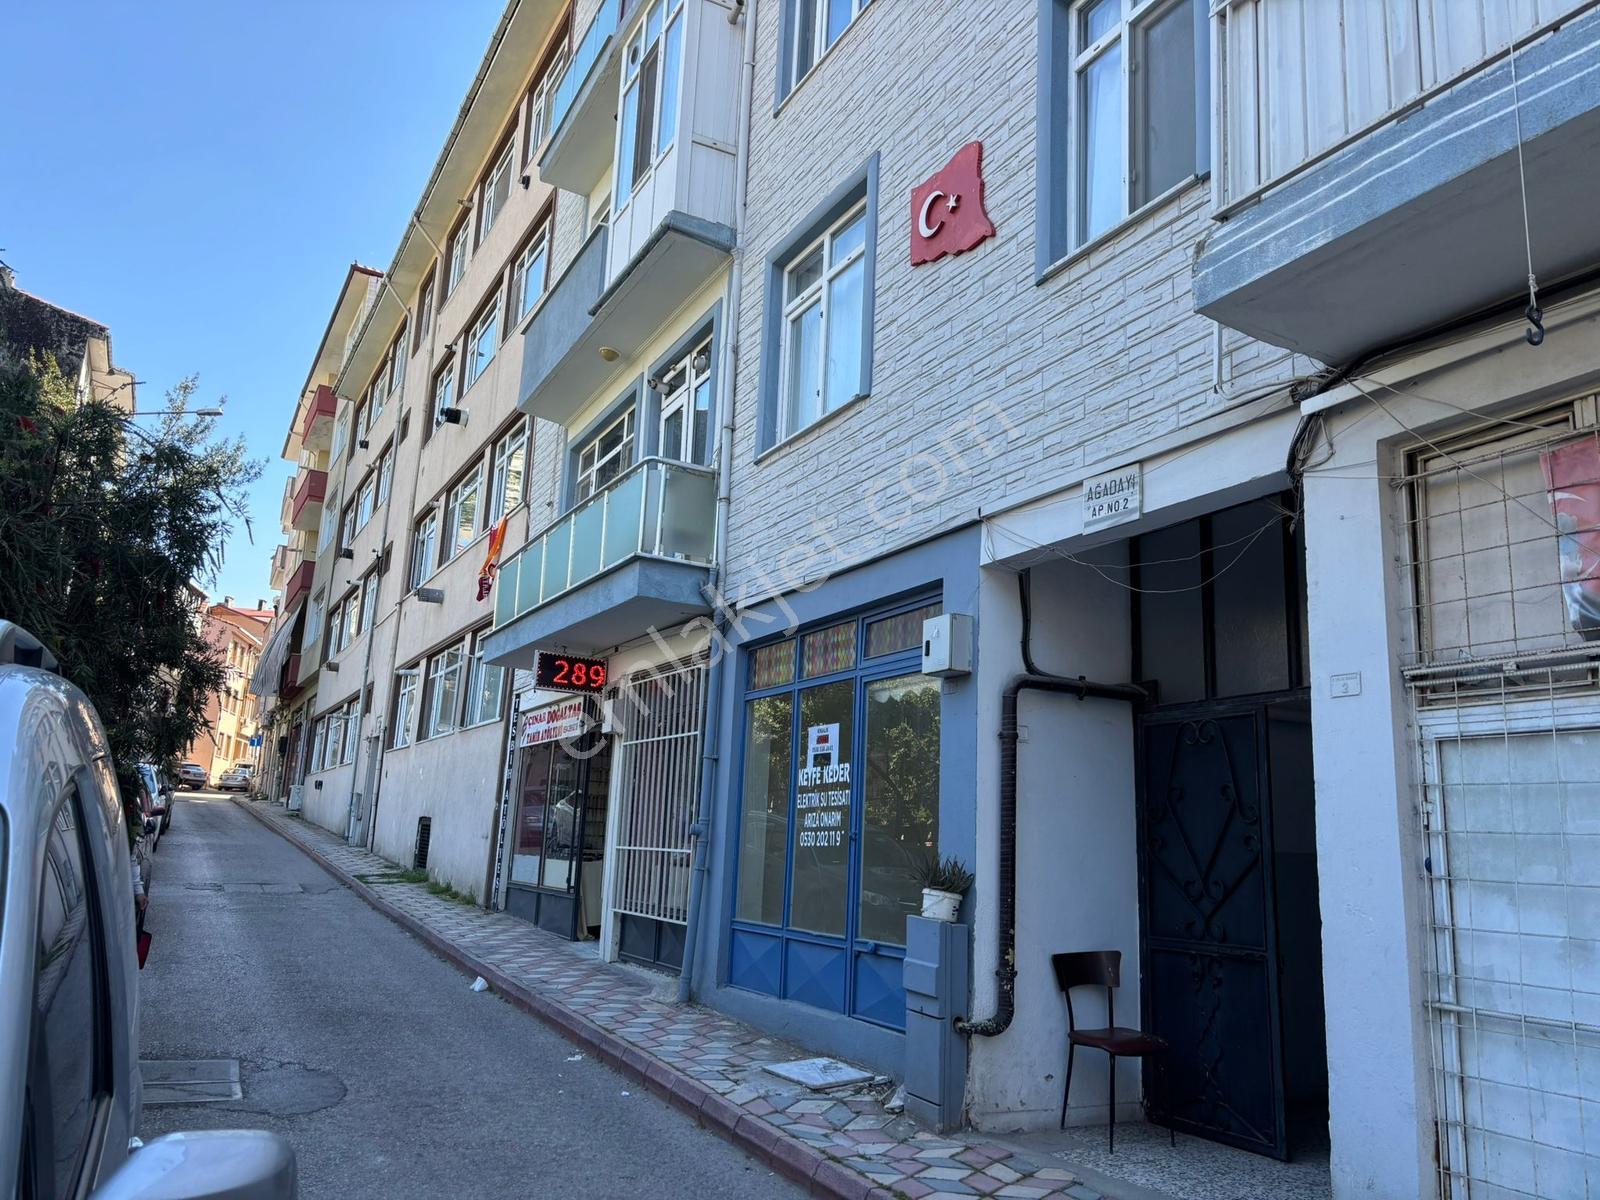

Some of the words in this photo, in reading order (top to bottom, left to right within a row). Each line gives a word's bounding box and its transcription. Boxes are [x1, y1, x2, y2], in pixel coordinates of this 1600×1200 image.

[552, 659, 606, 687] 289
[798, 766, 821, 787] KEYFE
[823, 762, 850, 784] KEDER
[820, 791, 828, 807] SU
[799, 831, 816, 847] 0530
[816, 830, 828, 847] 202
